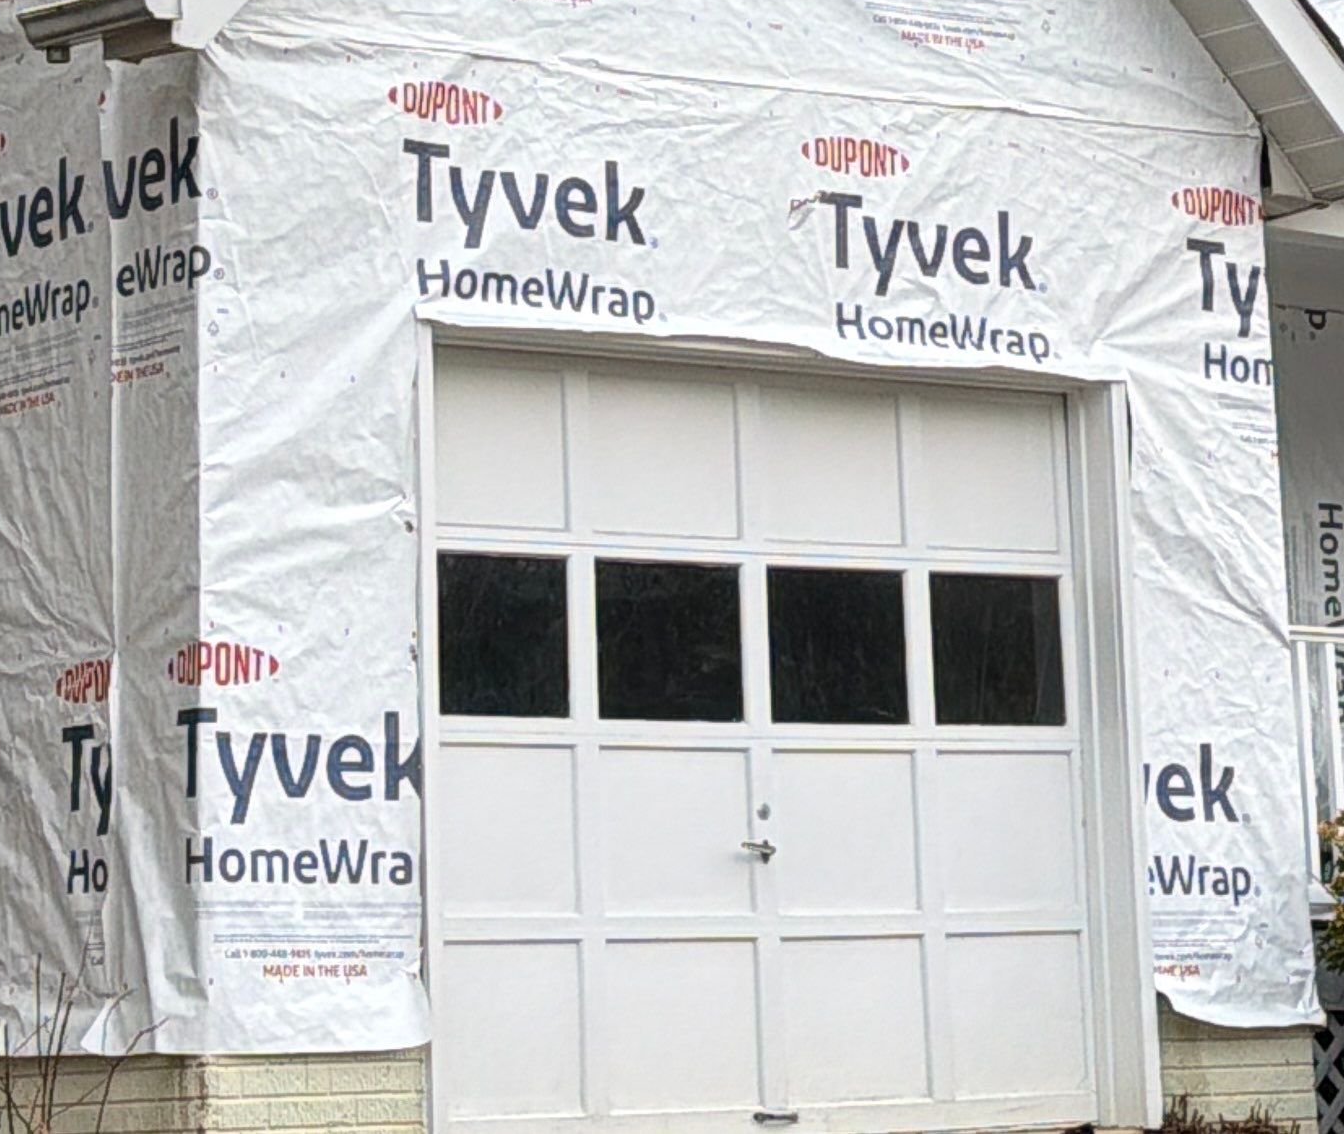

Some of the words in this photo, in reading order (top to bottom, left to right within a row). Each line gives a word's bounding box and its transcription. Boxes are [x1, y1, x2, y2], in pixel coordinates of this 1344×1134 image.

[402, 82, 491, 125] DUPONT
[102, 117, 202, 221] vek
[814, 137, 899, 177] DUPONT
[403, 138, 645, 248] Tyvek
[1184, 186, 1254, 226] DUPONT
[116, 243, 212, 297] eWrap
[819, 190, 1036, 297] Tyvek
[417, 258, 655, 325] HomeWrap
[836, 302, 1051, 366] HomeWrap
[177, 641, 265, 687] DUPONT
[176, 708, 422, 825] Tyvek
[185, 837, 413, 886] HomeWra
[263, 964, 300, 978] MADE
[303, 965, 316, 977] IN
[318, 965, 339, 977] THE
[344, 965, 368, 978] USA
